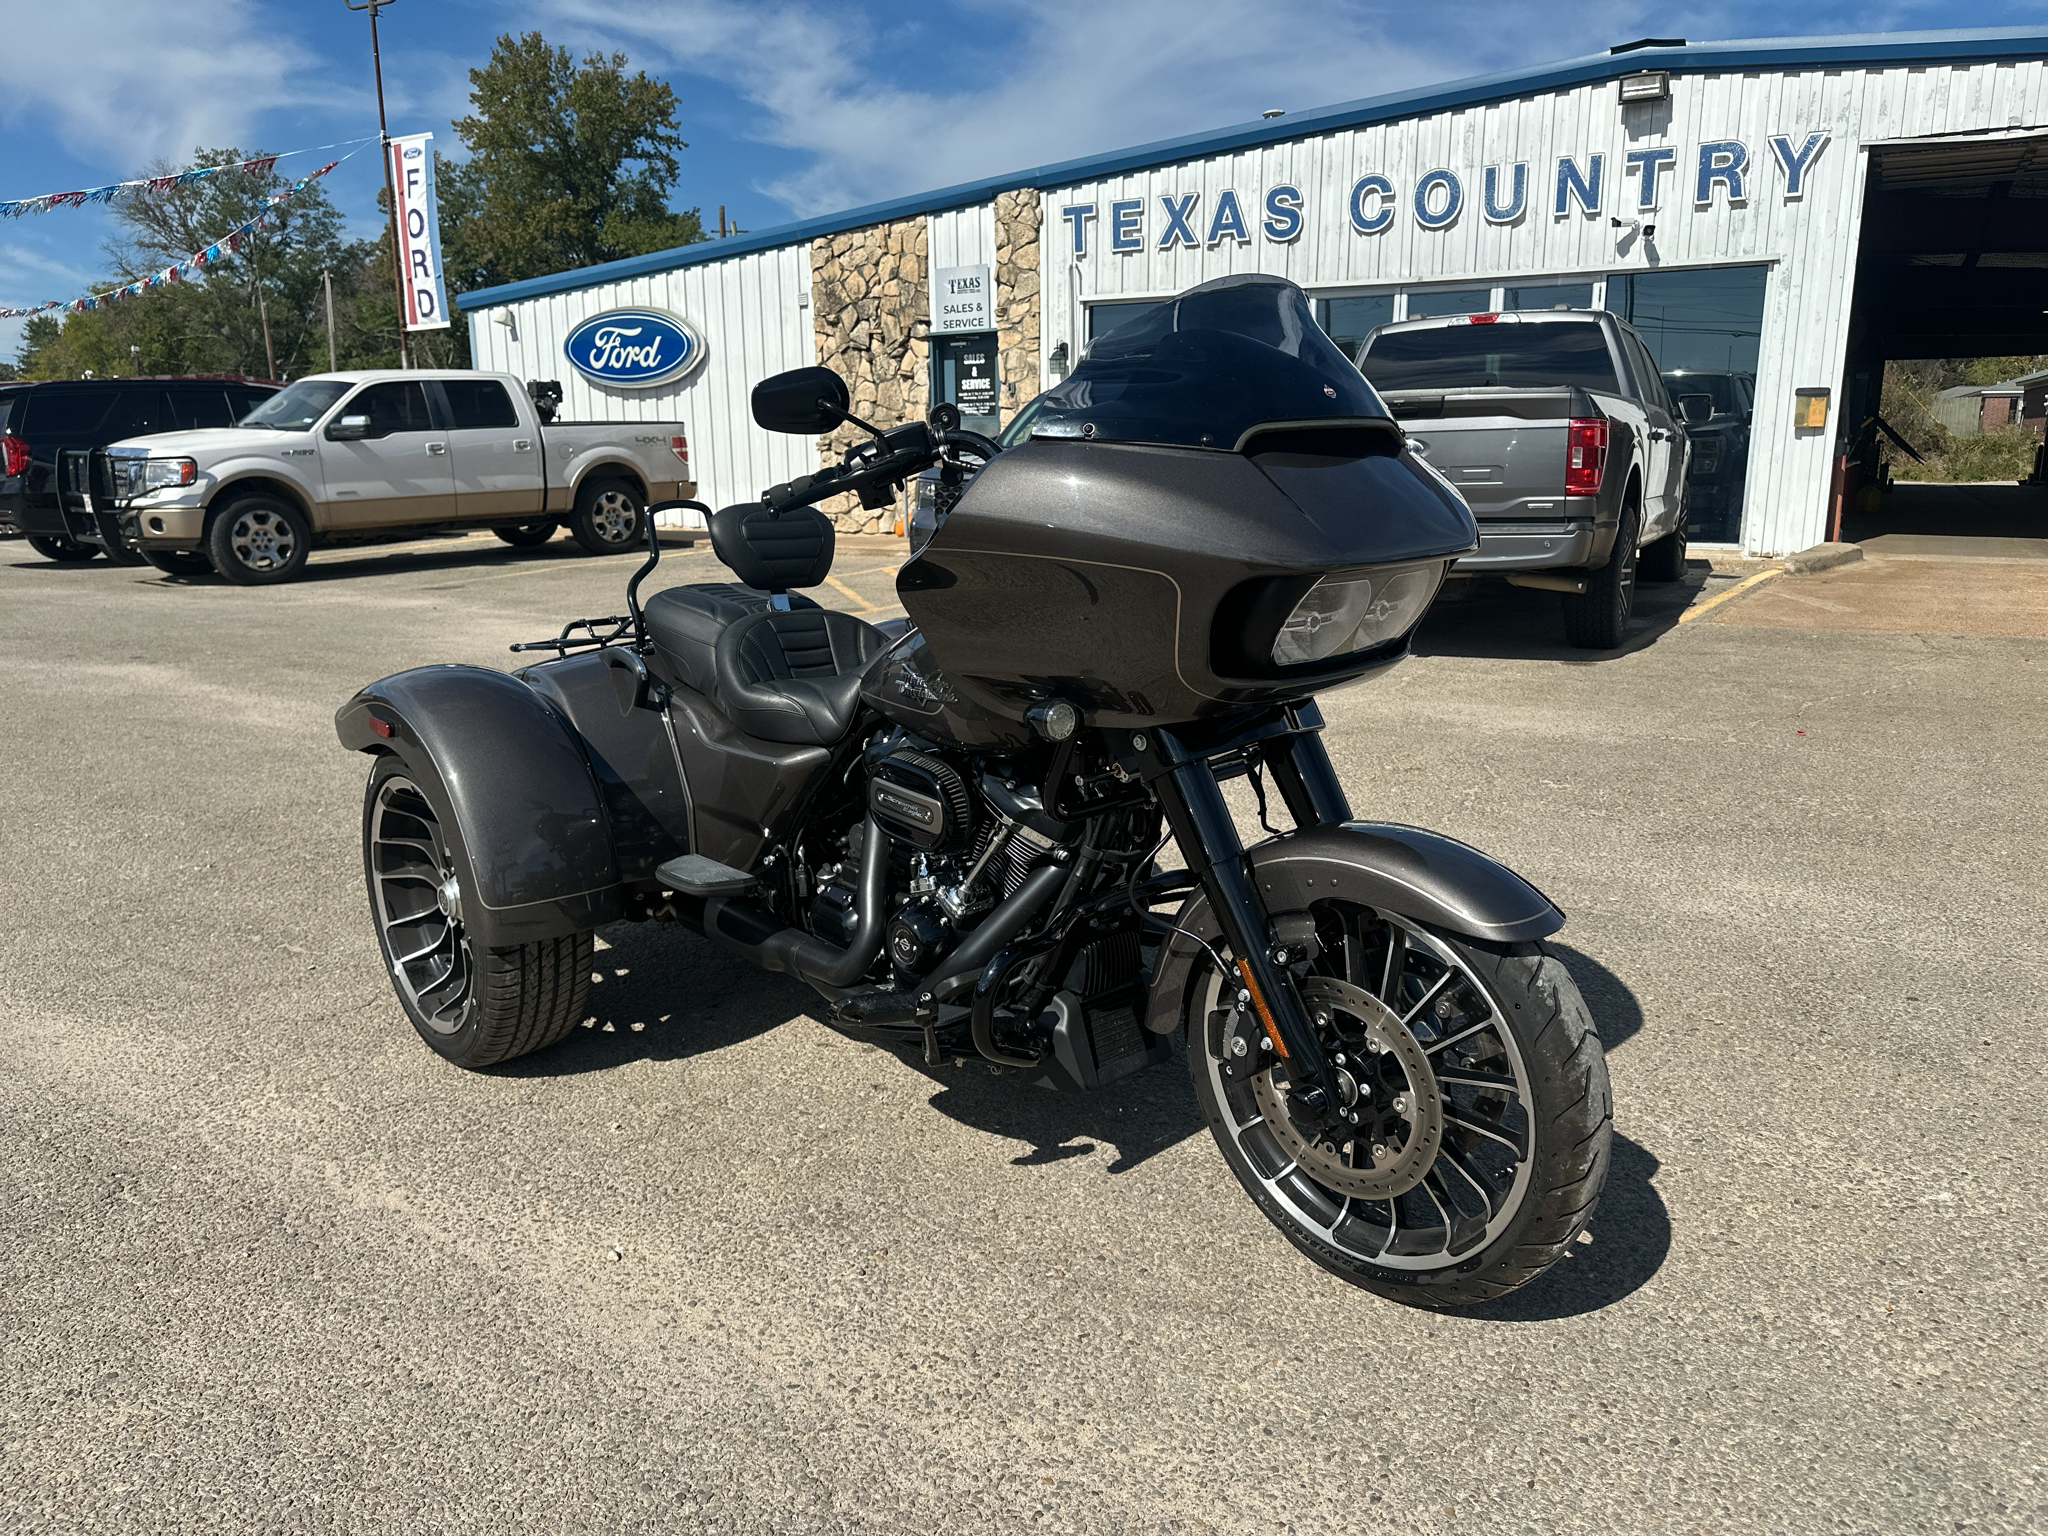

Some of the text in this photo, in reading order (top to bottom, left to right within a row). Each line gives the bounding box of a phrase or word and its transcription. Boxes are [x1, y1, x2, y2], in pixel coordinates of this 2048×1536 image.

[1061, 130, 1831, 255] TEXAS COUNTRY
[406, 168, 434, 318] FORD
[949, 276, 981, 294] TEXAS
[943, 302, 983, 314] SALES &
[943, 317, 984, 329] SERVICE
[589, 326, 662, 369] Ford
[963, 354, 986, 365] SALES
[961, 378, 991, 390] SERVICE
